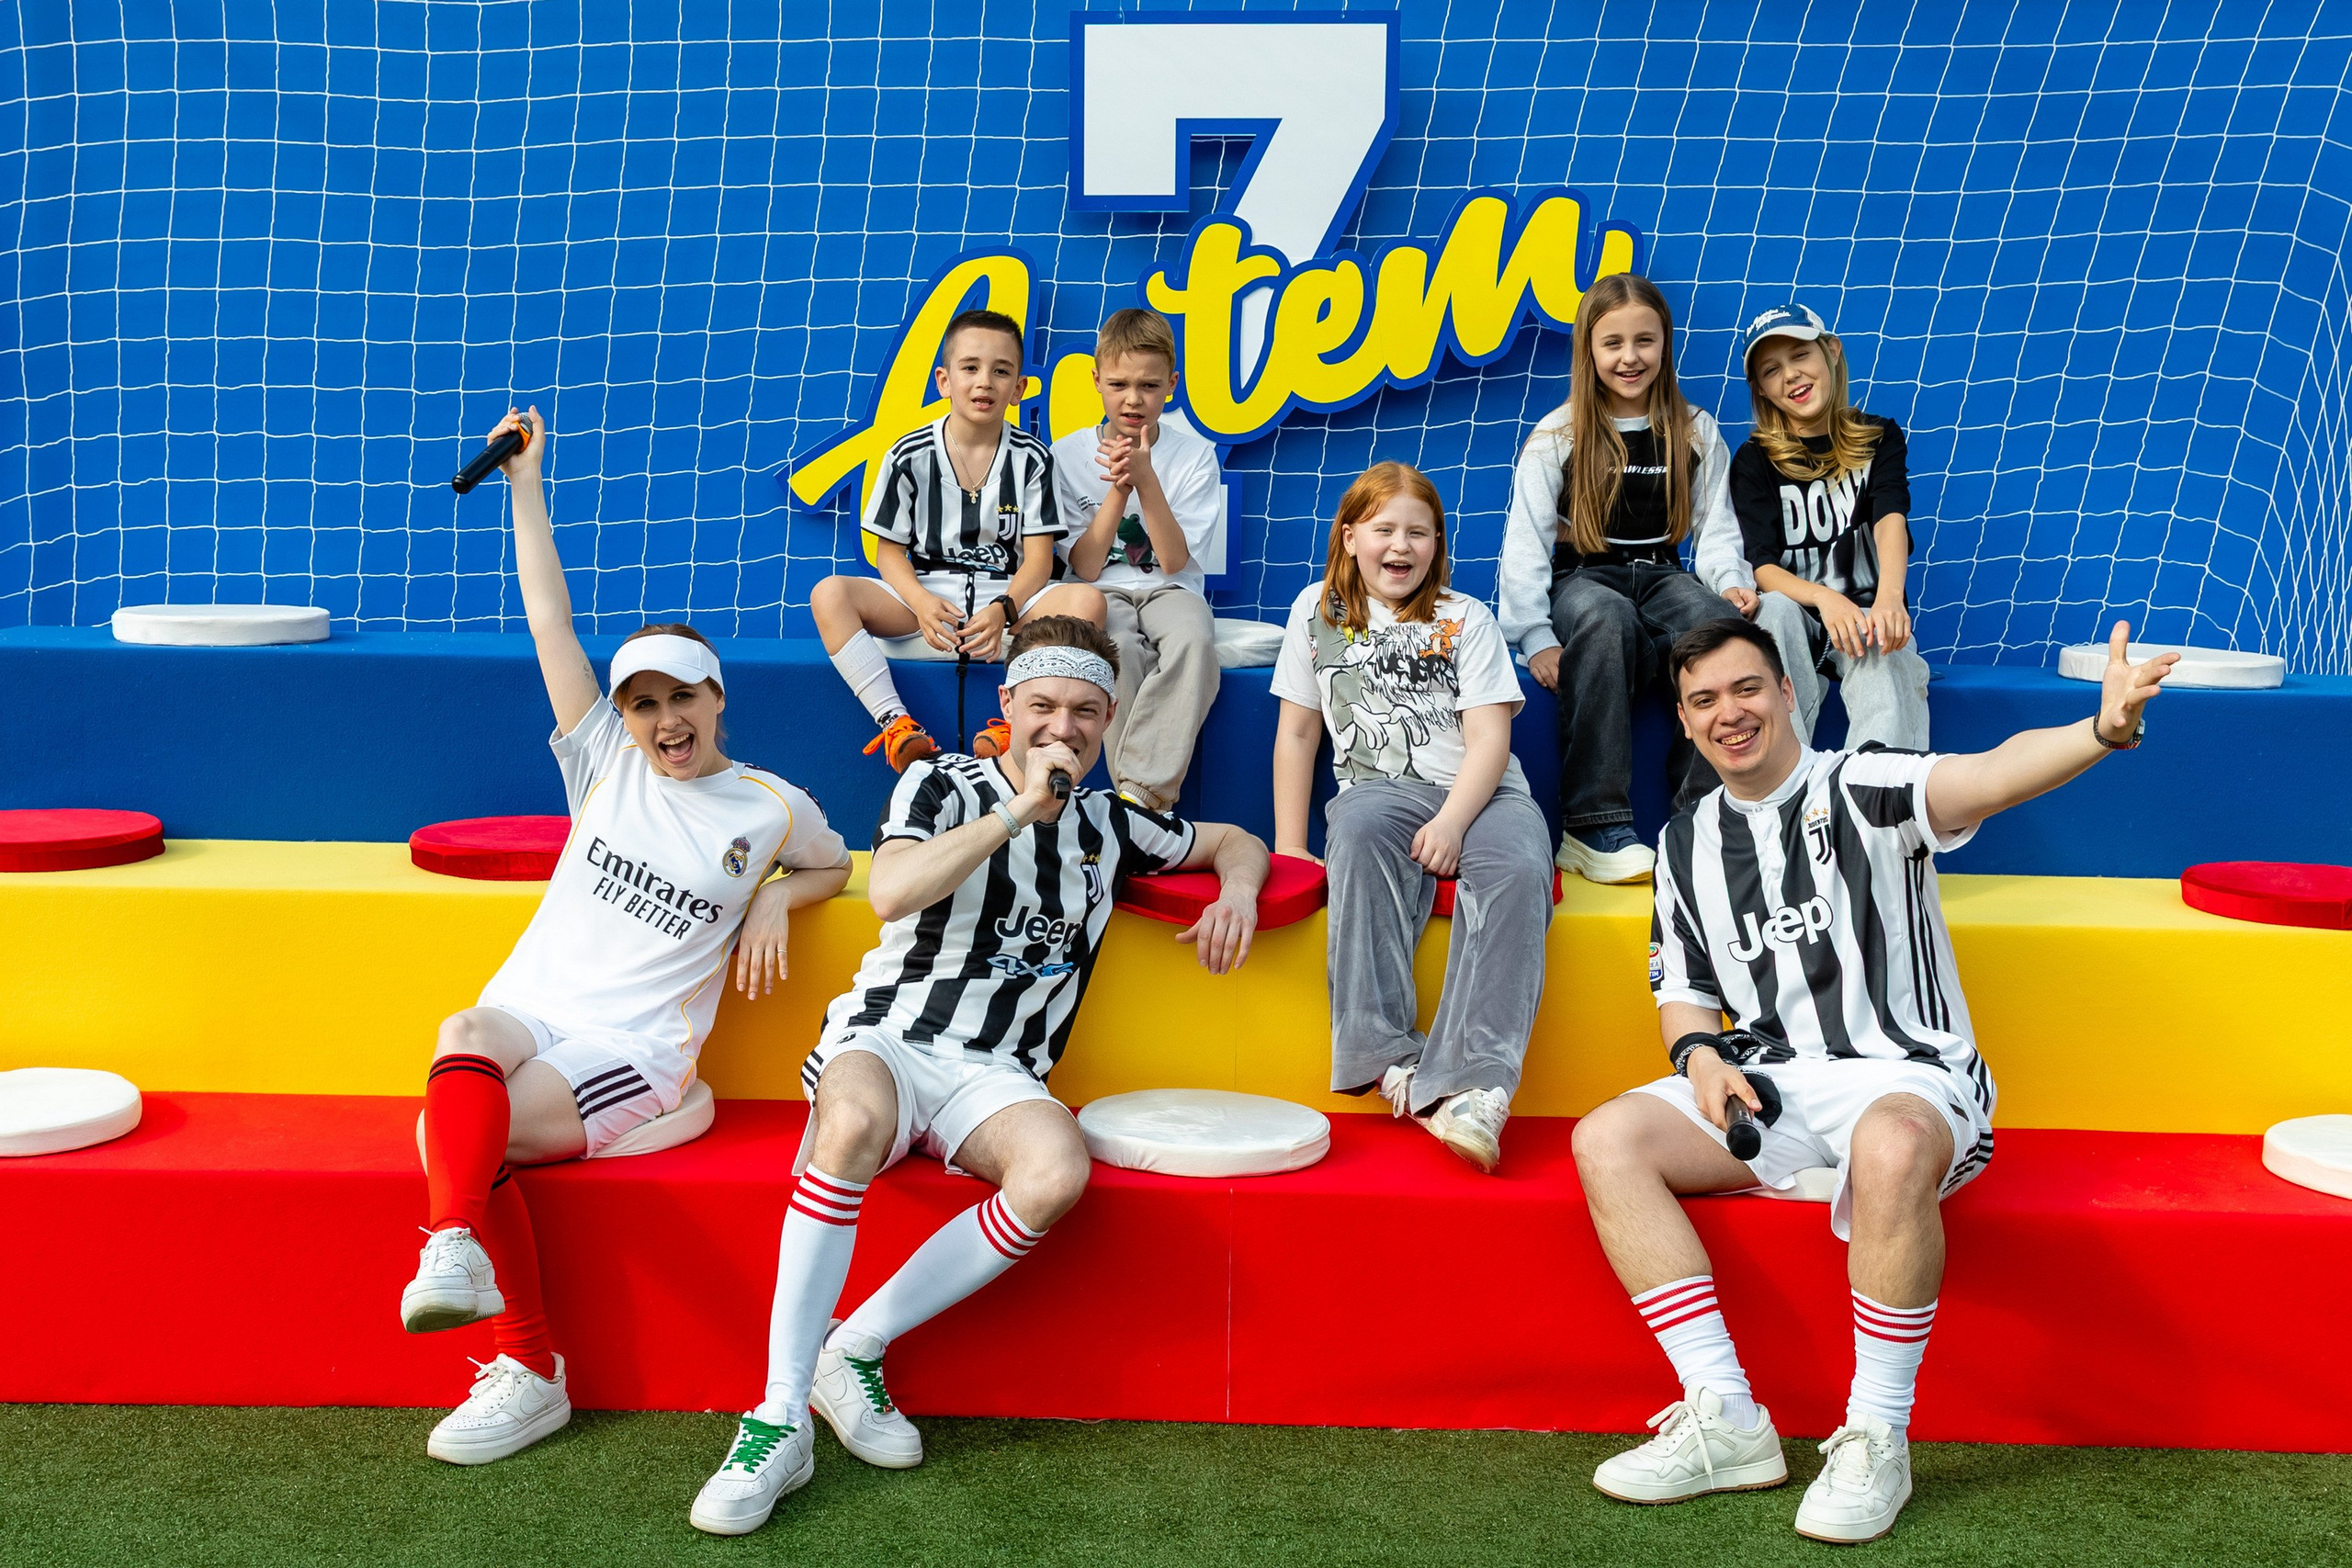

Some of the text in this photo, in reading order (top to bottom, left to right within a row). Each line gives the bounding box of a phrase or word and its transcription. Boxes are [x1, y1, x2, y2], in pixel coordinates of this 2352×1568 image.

[1084, 23, 1388, 574] 7
[586, 836, 723, 924] Emirates
[593, 876, 692, 941] FLY BETTER
[995, 905, 1082, 951] Jeep
[1727, 895, 1834, 963] Jeep
